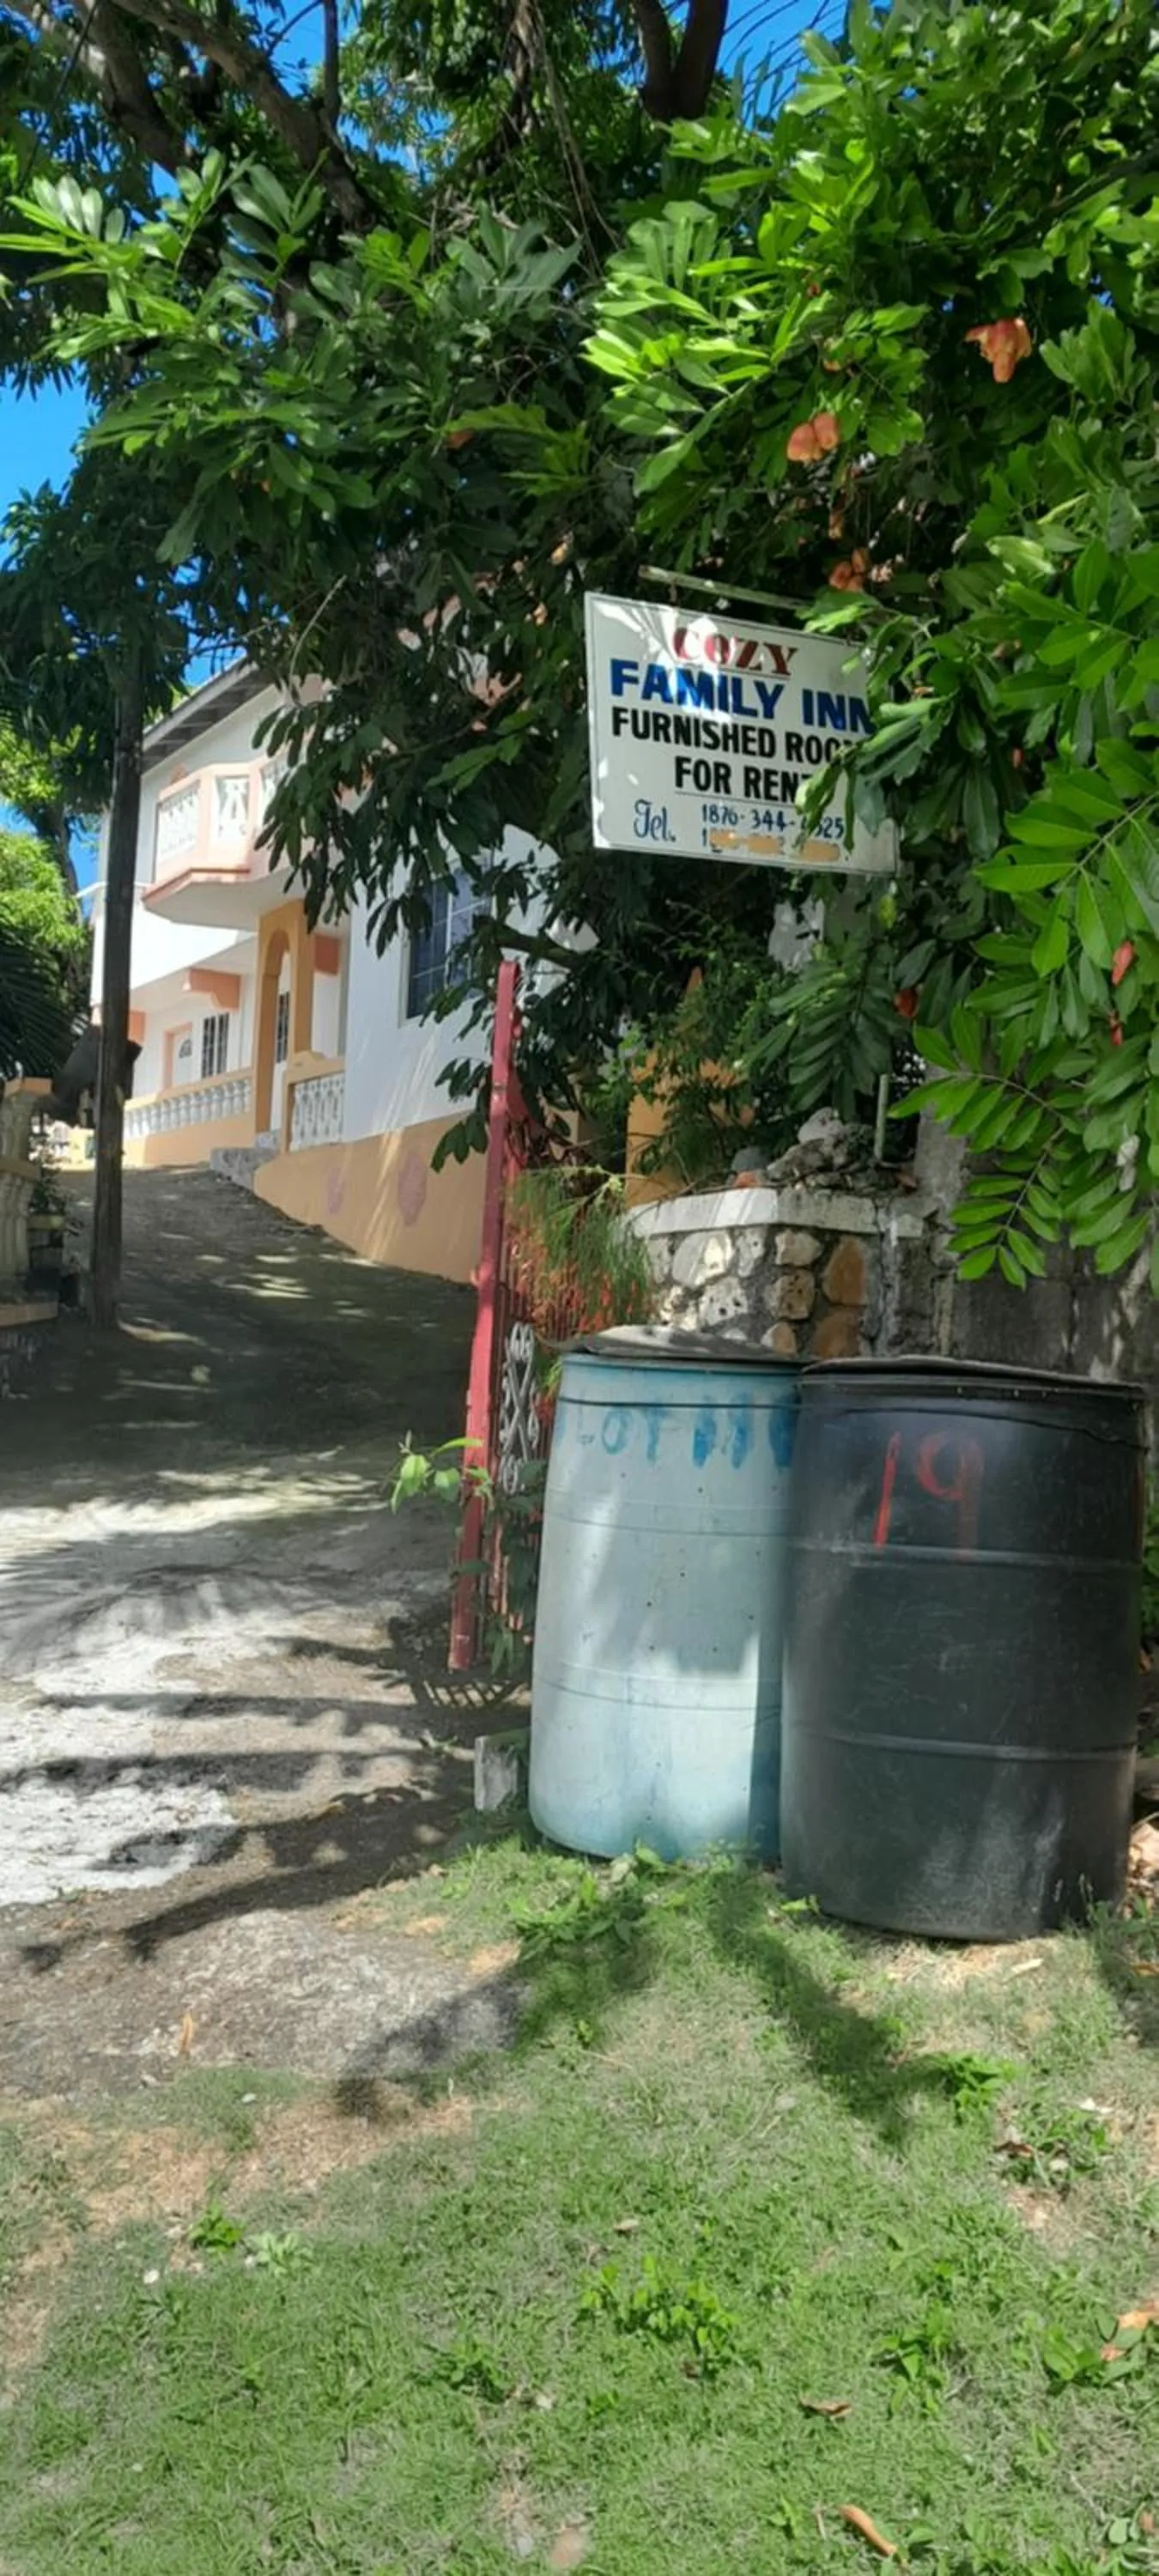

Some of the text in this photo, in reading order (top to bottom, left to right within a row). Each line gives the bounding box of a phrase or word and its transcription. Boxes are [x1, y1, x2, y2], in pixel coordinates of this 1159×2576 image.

[673, 627, 798, 677] COZY
[610, 658, 878, 735] FAMILY INN
[611, 706, 854, 765] FURNISHED ROO
[675, 756, 812, 804] FOR REN
[872, 1430, 986, 1557] 19
